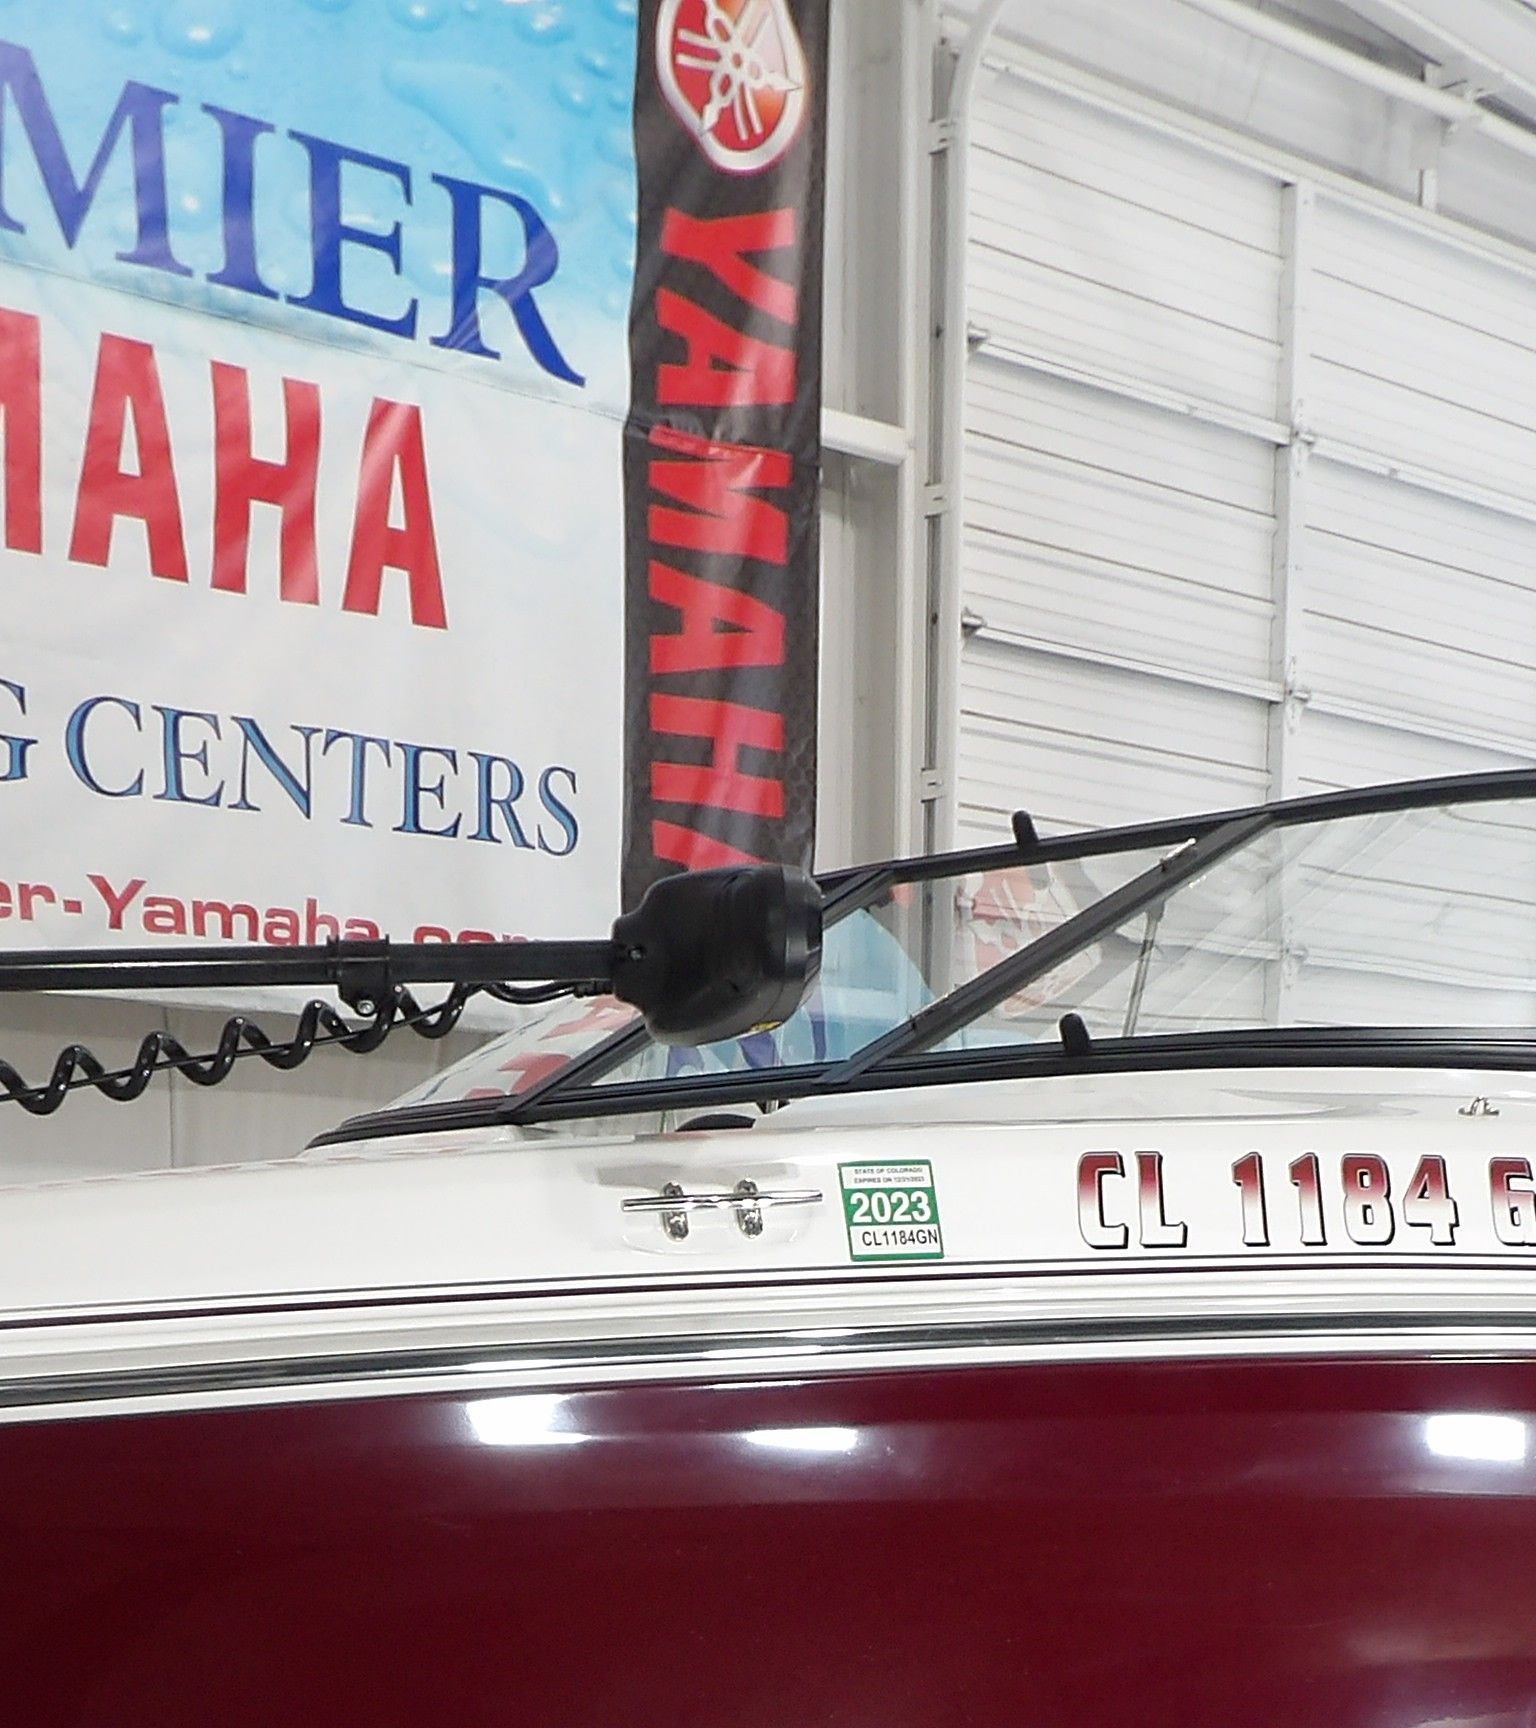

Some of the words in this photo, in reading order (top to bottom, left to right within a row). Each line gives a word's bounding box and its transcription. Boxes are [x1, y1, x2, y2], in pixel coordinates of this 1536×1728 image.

[64, 695, 582, 857] CENTERS
[849, 1190, 932, 1223] 2023
[1076, 1150, 1188, 1249] CL
[1230, 1151, 1460, 1248] 1184
[861, 1228, 938, 1247] CL1184GN
